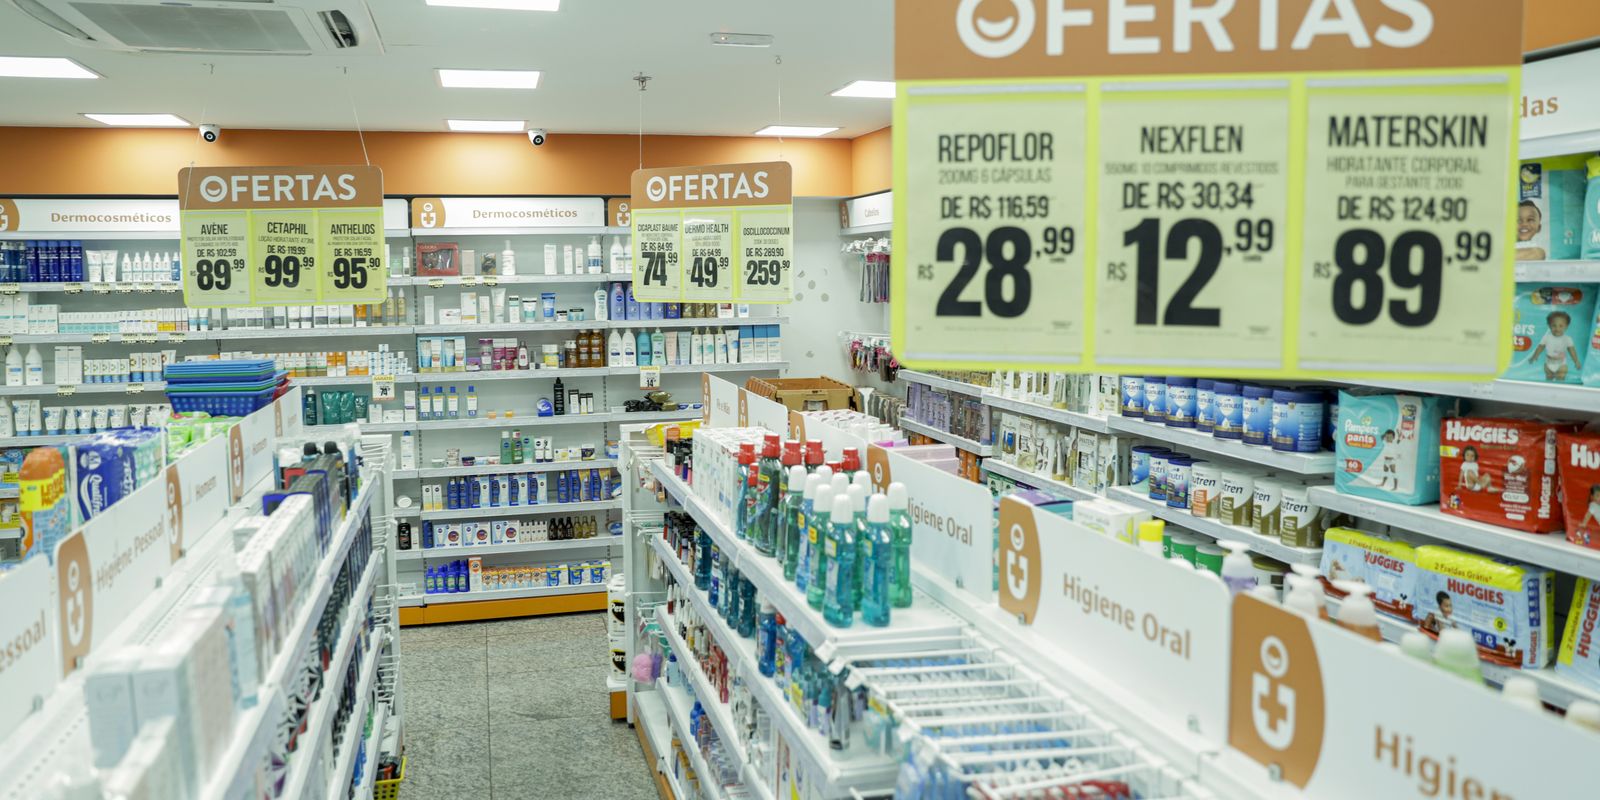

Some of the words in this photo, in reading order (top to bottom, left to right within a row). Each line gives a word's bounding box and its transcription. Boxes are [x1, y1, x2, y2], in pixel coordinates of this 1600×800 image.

[956, 0, 1435, 58] OFERTAS
[1328, 115, 1487, 148] MATERSKIN
[1141, 126, 1243, 154] NEXFLEN
[938, 132, 1053, 163] REPOFLOR
[1327, 156, 1408, 173] HIDRATANTE
[1411, 157, 1482, 174] CORPORAL
[200, 174, 357, 202] OFERTAS
[646, 171, 769, 202] OFERTAS
[1345, 175, 1374, 188] PARA
[1122, 182, 1150, 209] DE
[1157, 181, 1185, 211] R$
[1192, 181, 1254, 212] 30,34
[472, 208, 578, 219] Dermocosméticos
[941, 196, 963, 219] DE
[969, 195, 992, 219] R$
[998, 195, 1050, 221] 116,59
[1337, 196, 1362, 220] DE
[1369, 196, 1395, 221] R$
[1402, 197, 1468, 223] 124,90
[51, 212, 172, 223] Dermocosméticos
[267, 222, 308, 235] CETAPHIL
[331, 224, 375, 234] ANTHELIOS
[638, 224, 661, 232] CICAPLAST
[662, 223, 678, 232] BAUME
[706, 223, 729, 233] HEALTH
[197, 249, 205, 257] DE
[267, 245, 276, 254] DE
[334, 248, 342, 256] DE
[641, 242, 648, 251] DE
[692, 249, 699, 257] DE
[746, 248, 753, 257] DE
[1345, 419, 1379, 435] Pampers
[1446, 420, 1519, 444] HUGGIES
[1347, 434, 1374, 443] pants
[1348, 461, 1358, 469] 60
[1191, 475, 1216, 486] utren
[1224, 483, 1243, 495] tren
[1281, 500, 1308, 513] utren
[947, 517, 973, 547] Oral
[1440, 564, 1466, 577] Fraldas
[1447, 578, 1504, 605] HUGGIES
[1063, 572, 1135, 632] Higiene
[1142, 612, 1191, 660] Oral
[0, 608, 46, 673] essoal
